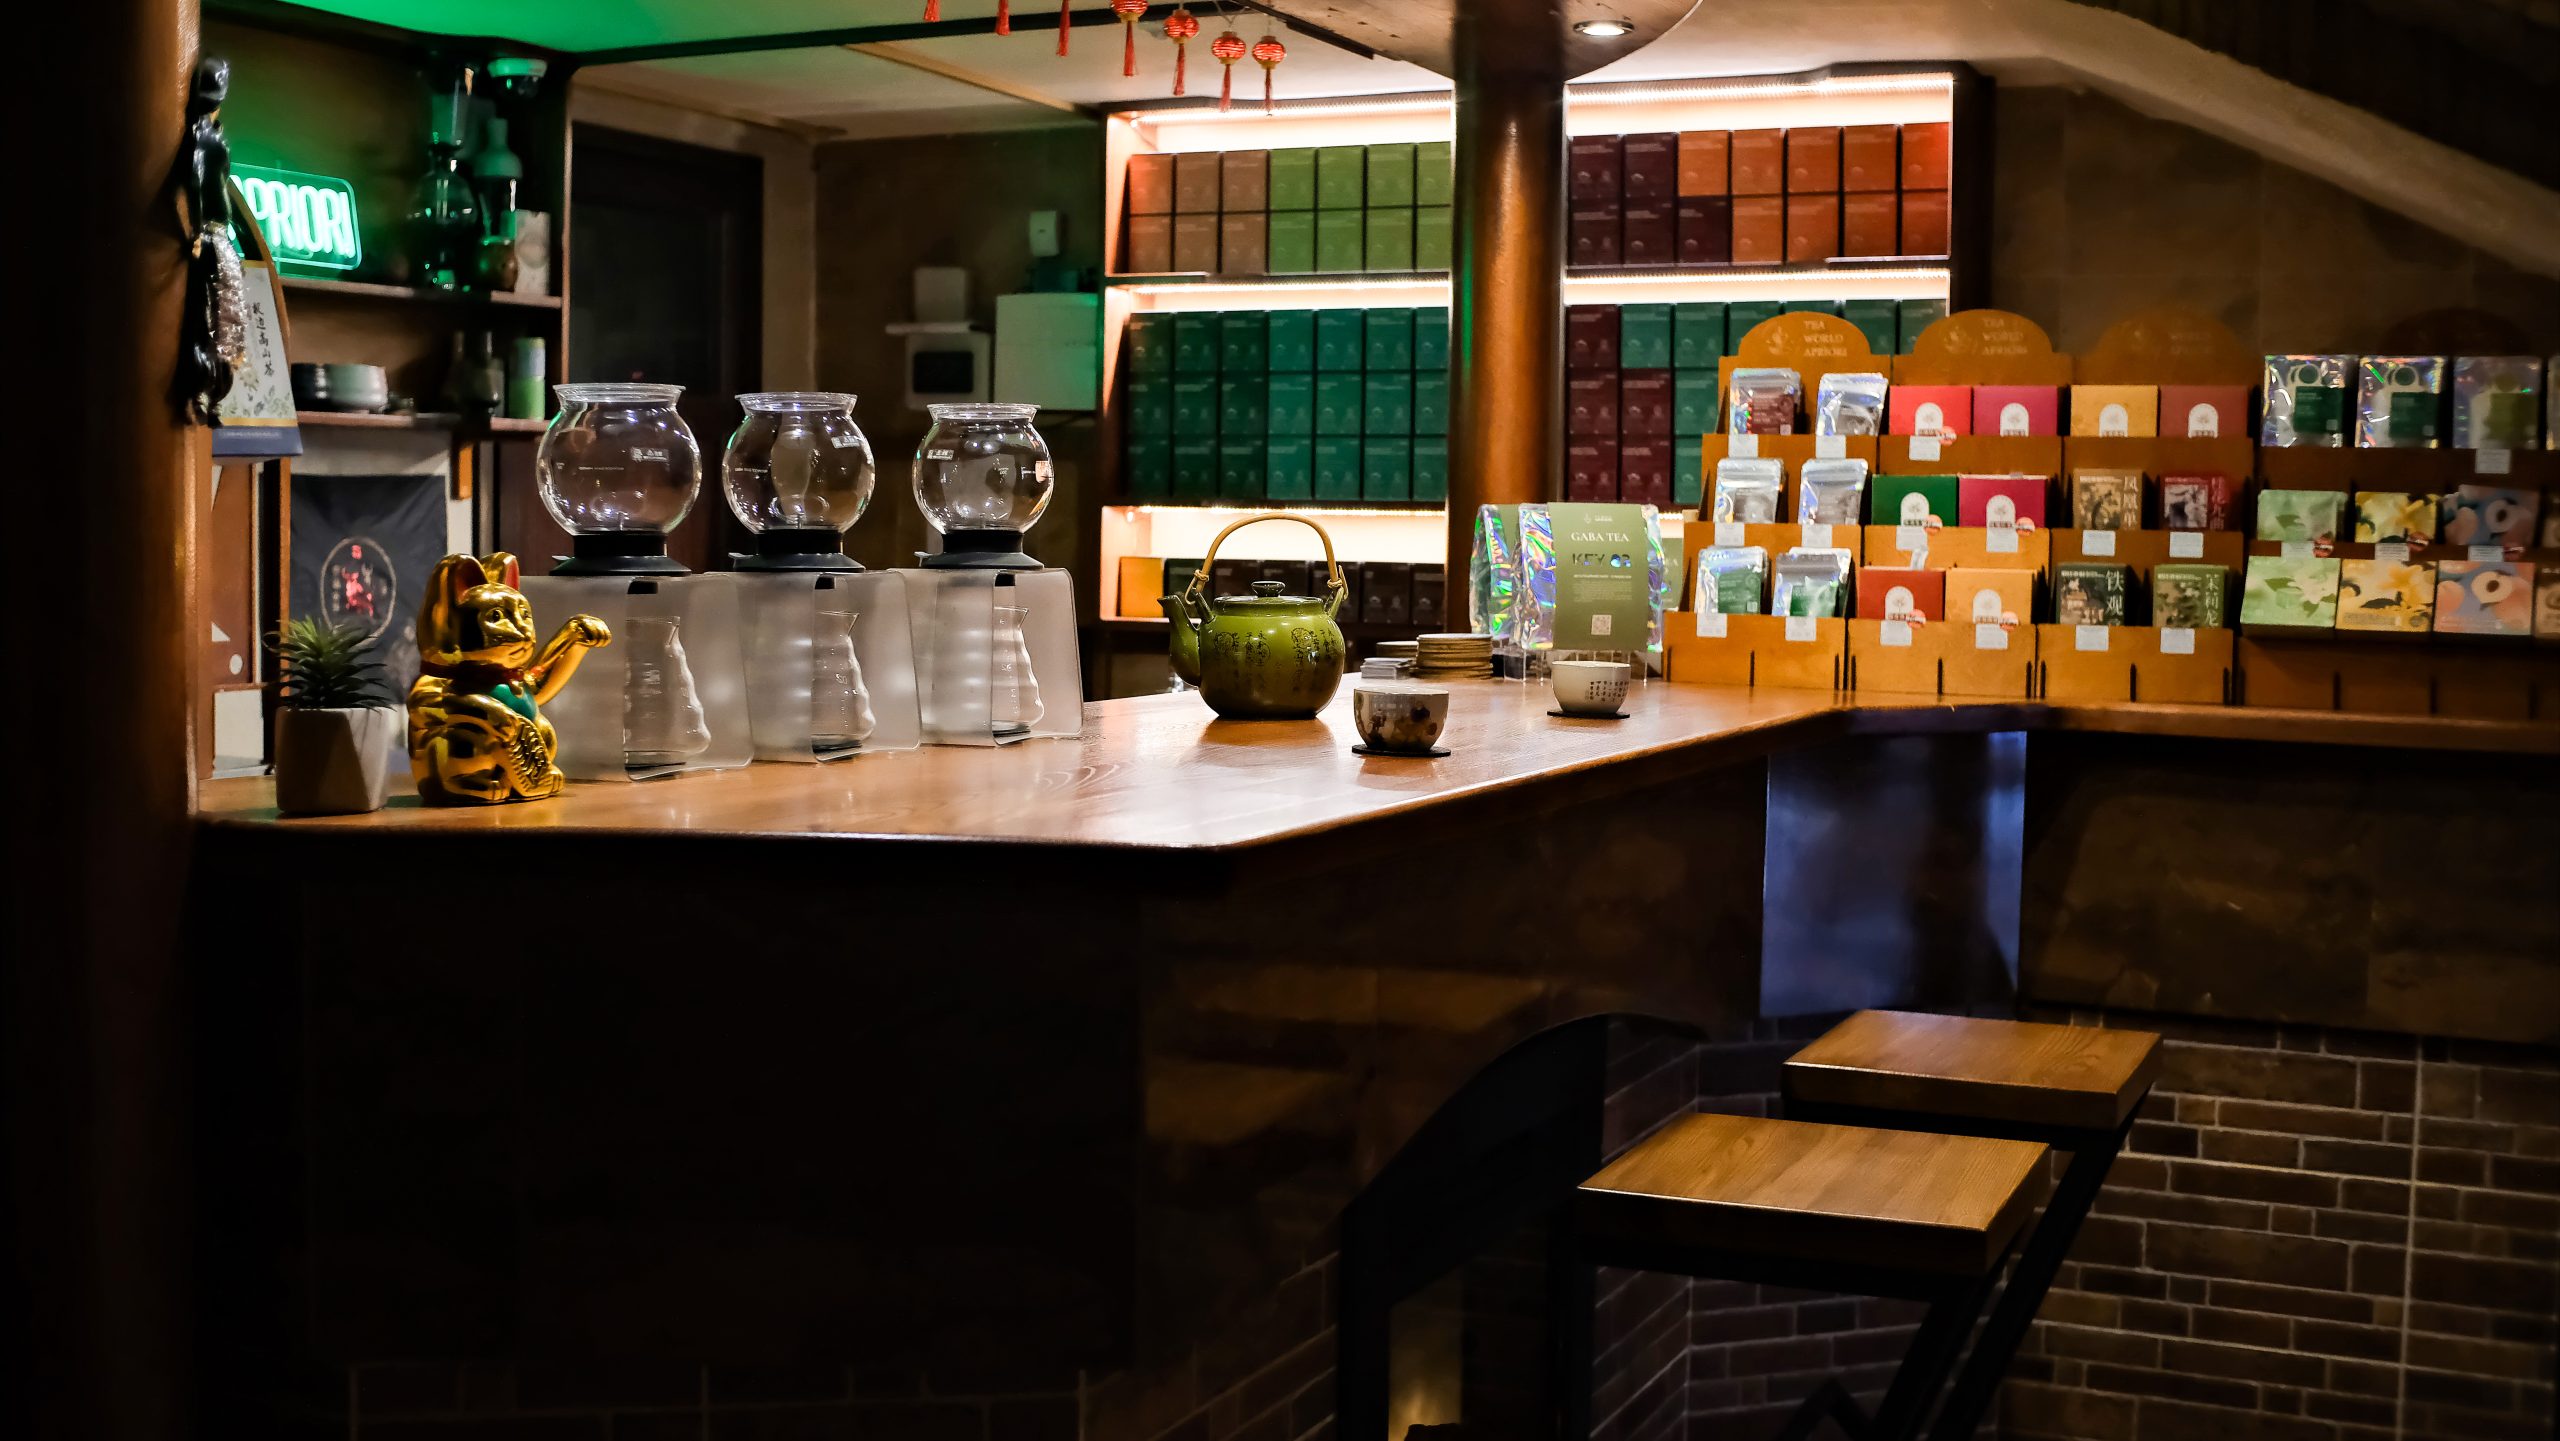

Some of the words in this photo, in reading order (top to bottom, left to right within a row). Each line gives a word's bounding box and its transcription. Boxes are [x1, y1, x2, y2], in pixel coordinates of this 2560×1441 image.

[2123, 475, 2139, 529] 凤凰单
[1570, 532, 1604, 542] GABA
[1606, 532, 1629, 543] TEA
